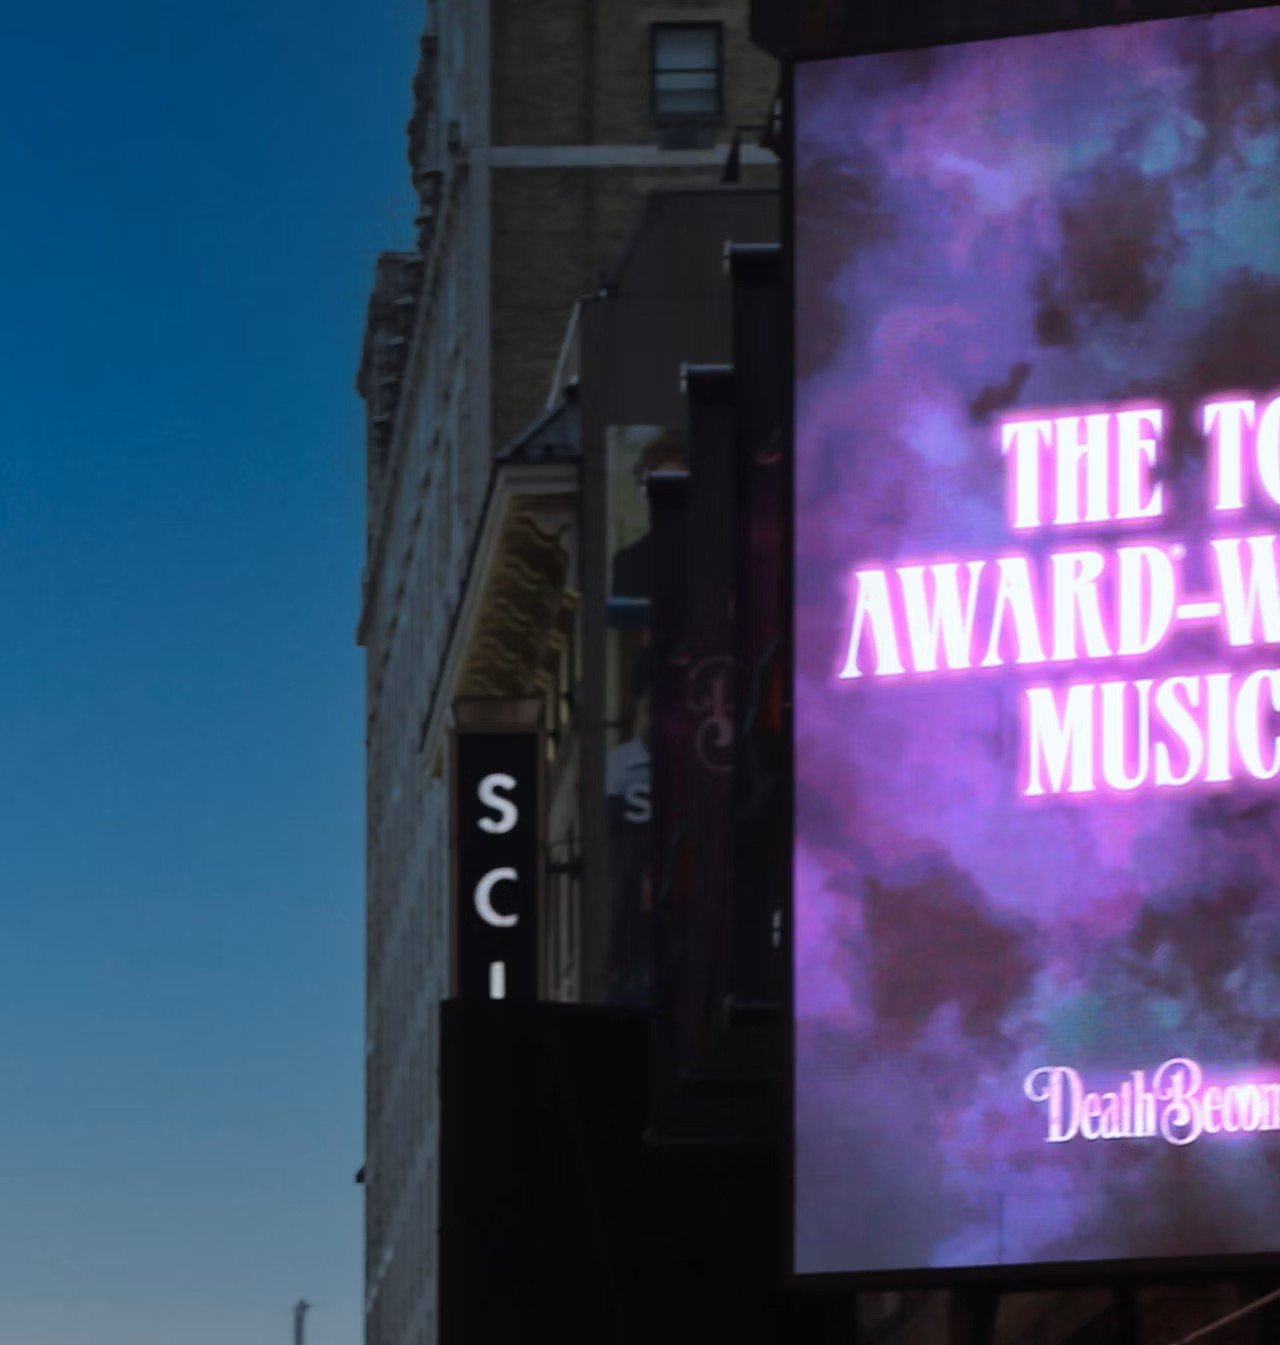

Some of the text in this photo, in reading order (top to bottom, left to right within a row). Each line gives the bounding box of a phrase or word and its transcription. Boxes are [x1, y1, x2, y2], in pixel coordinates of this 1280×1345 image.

[1002, 408, 1162, 529] THE
[1024, 669, 1280, 795] MUSIC
[1023, 1065, 1157, 1144] Death
